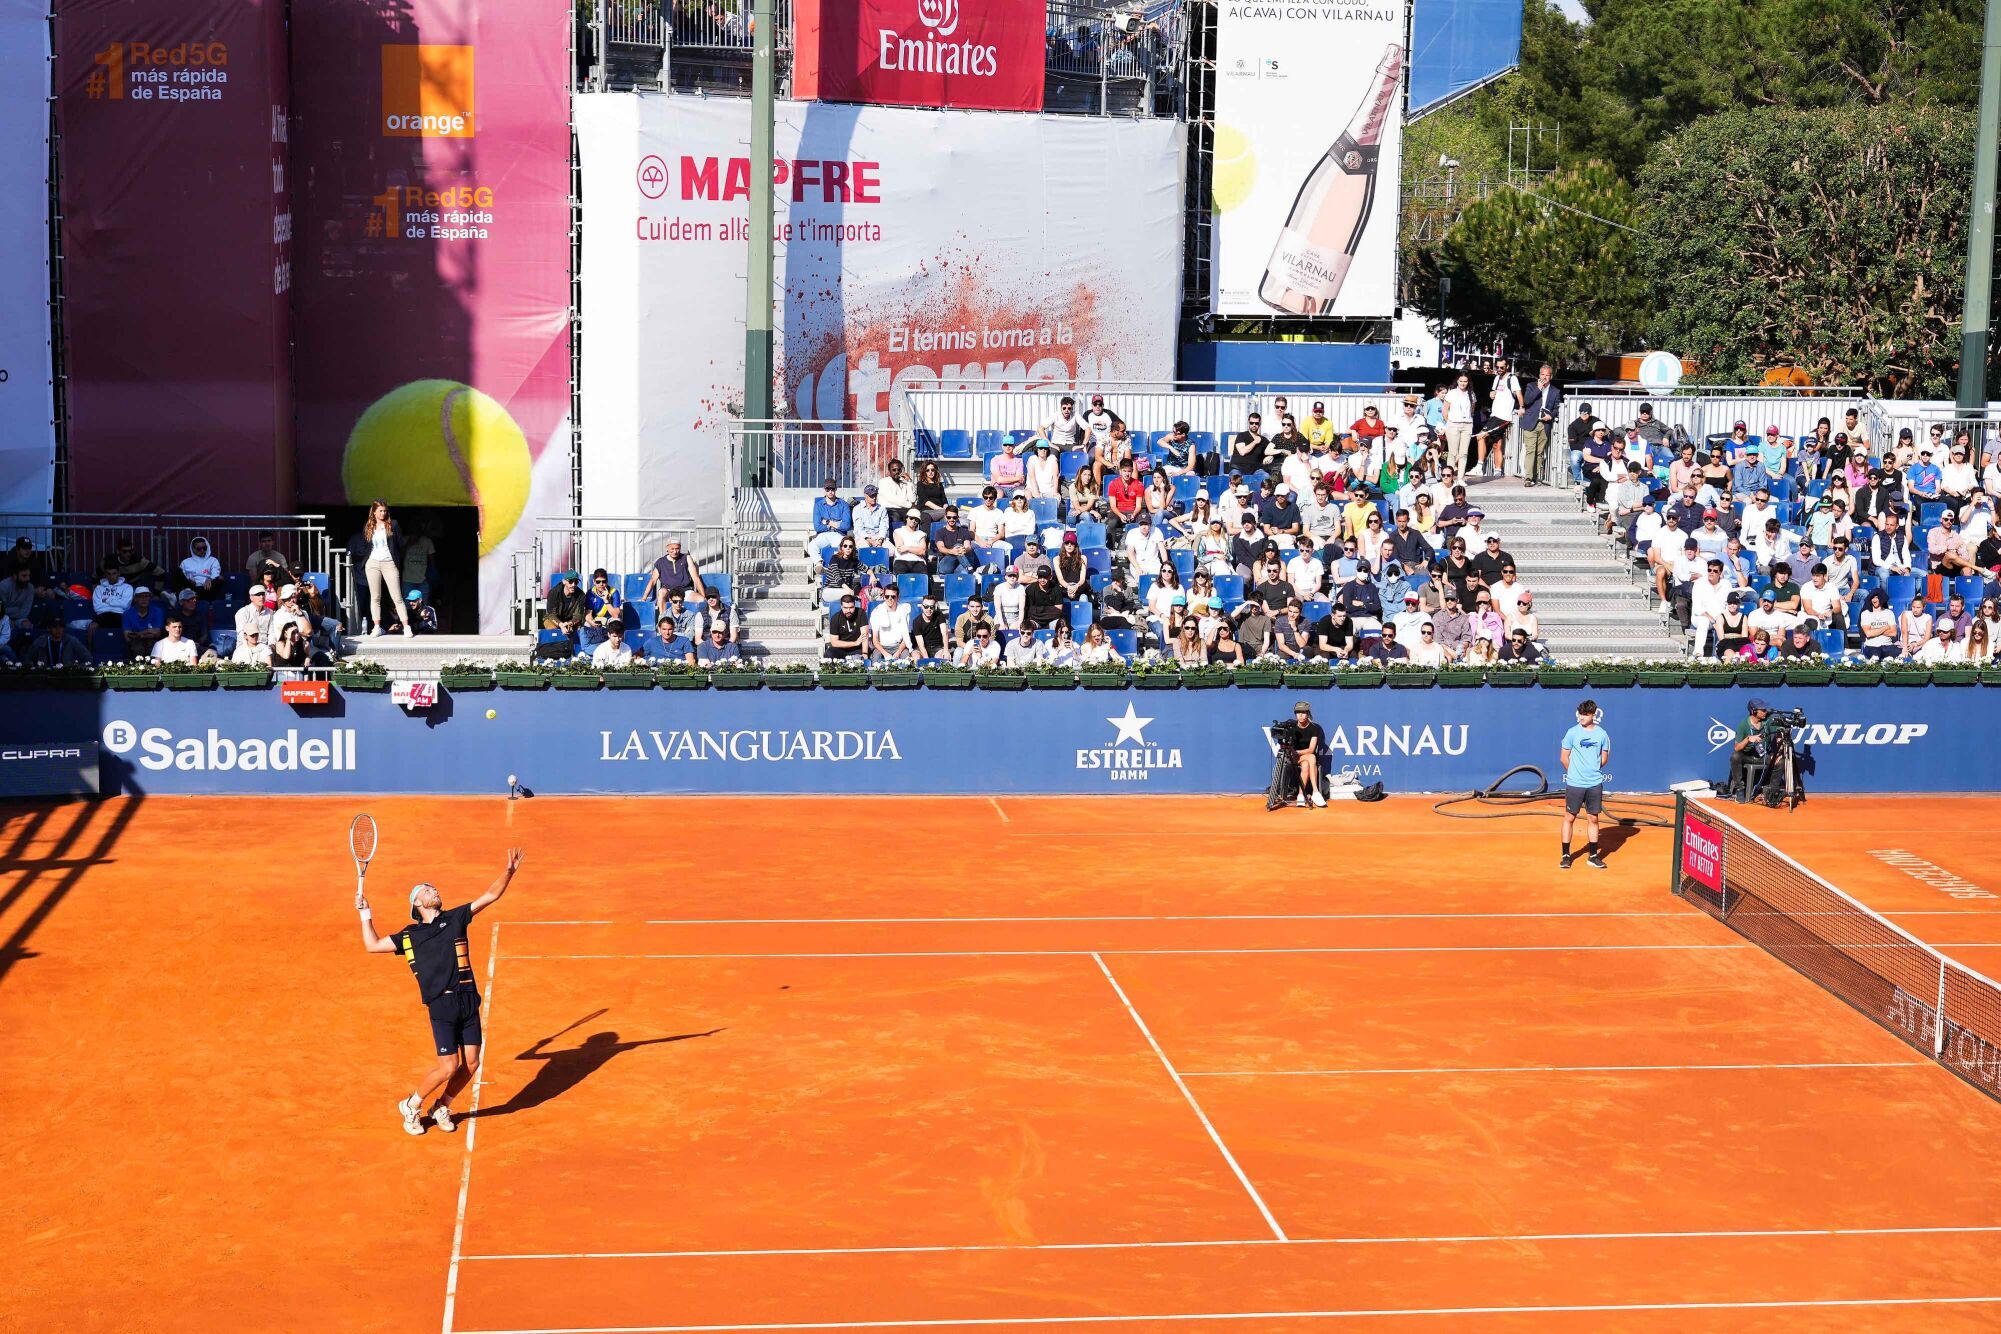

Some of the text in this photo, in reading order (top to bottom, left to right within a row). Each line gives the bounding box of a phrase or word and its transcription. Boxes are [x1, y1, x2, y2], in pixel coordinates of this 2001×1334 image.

[1229, 6, 1394, 22] A(CAVA) CON VILARNAU
[878, 29, 997, 77] Emirates
[131, 68, 227, 85] más rápida
[131, 85, 222, 103] de España
[387, 113, 464, 135] orange
[406, 209, 493, 226] más rápida
[406, 225, 488, 241] de España
[637, 216, 881, 247] Cuidem allò ue t'importa
[1282, 251, 1337, 282] VILARNAU
[888, 321, 1073, 352] El tennis torna a la
[1391, 346, 1414, 357] LAYERS
[319, 688, 327, 699] 2
[1261, 724, 1470, 757] VARNAU
[1790, 723, 1929, 745] UNLOP
[2, 748, 80, 760] CUPRA
[139, 728, 356, 771] Sabadell
[599, 729, 902, 762] LA VANGUARDIA
[1076, 748, 1183, 769] ESTRELLA
[1110, 770, 1148, 781] DAMM
[1341, 764, 1382, 777] CAVA
[1685, 825, 1719, 862] Emirates
[1689, 850, 1714, 879] FLY BETTER
